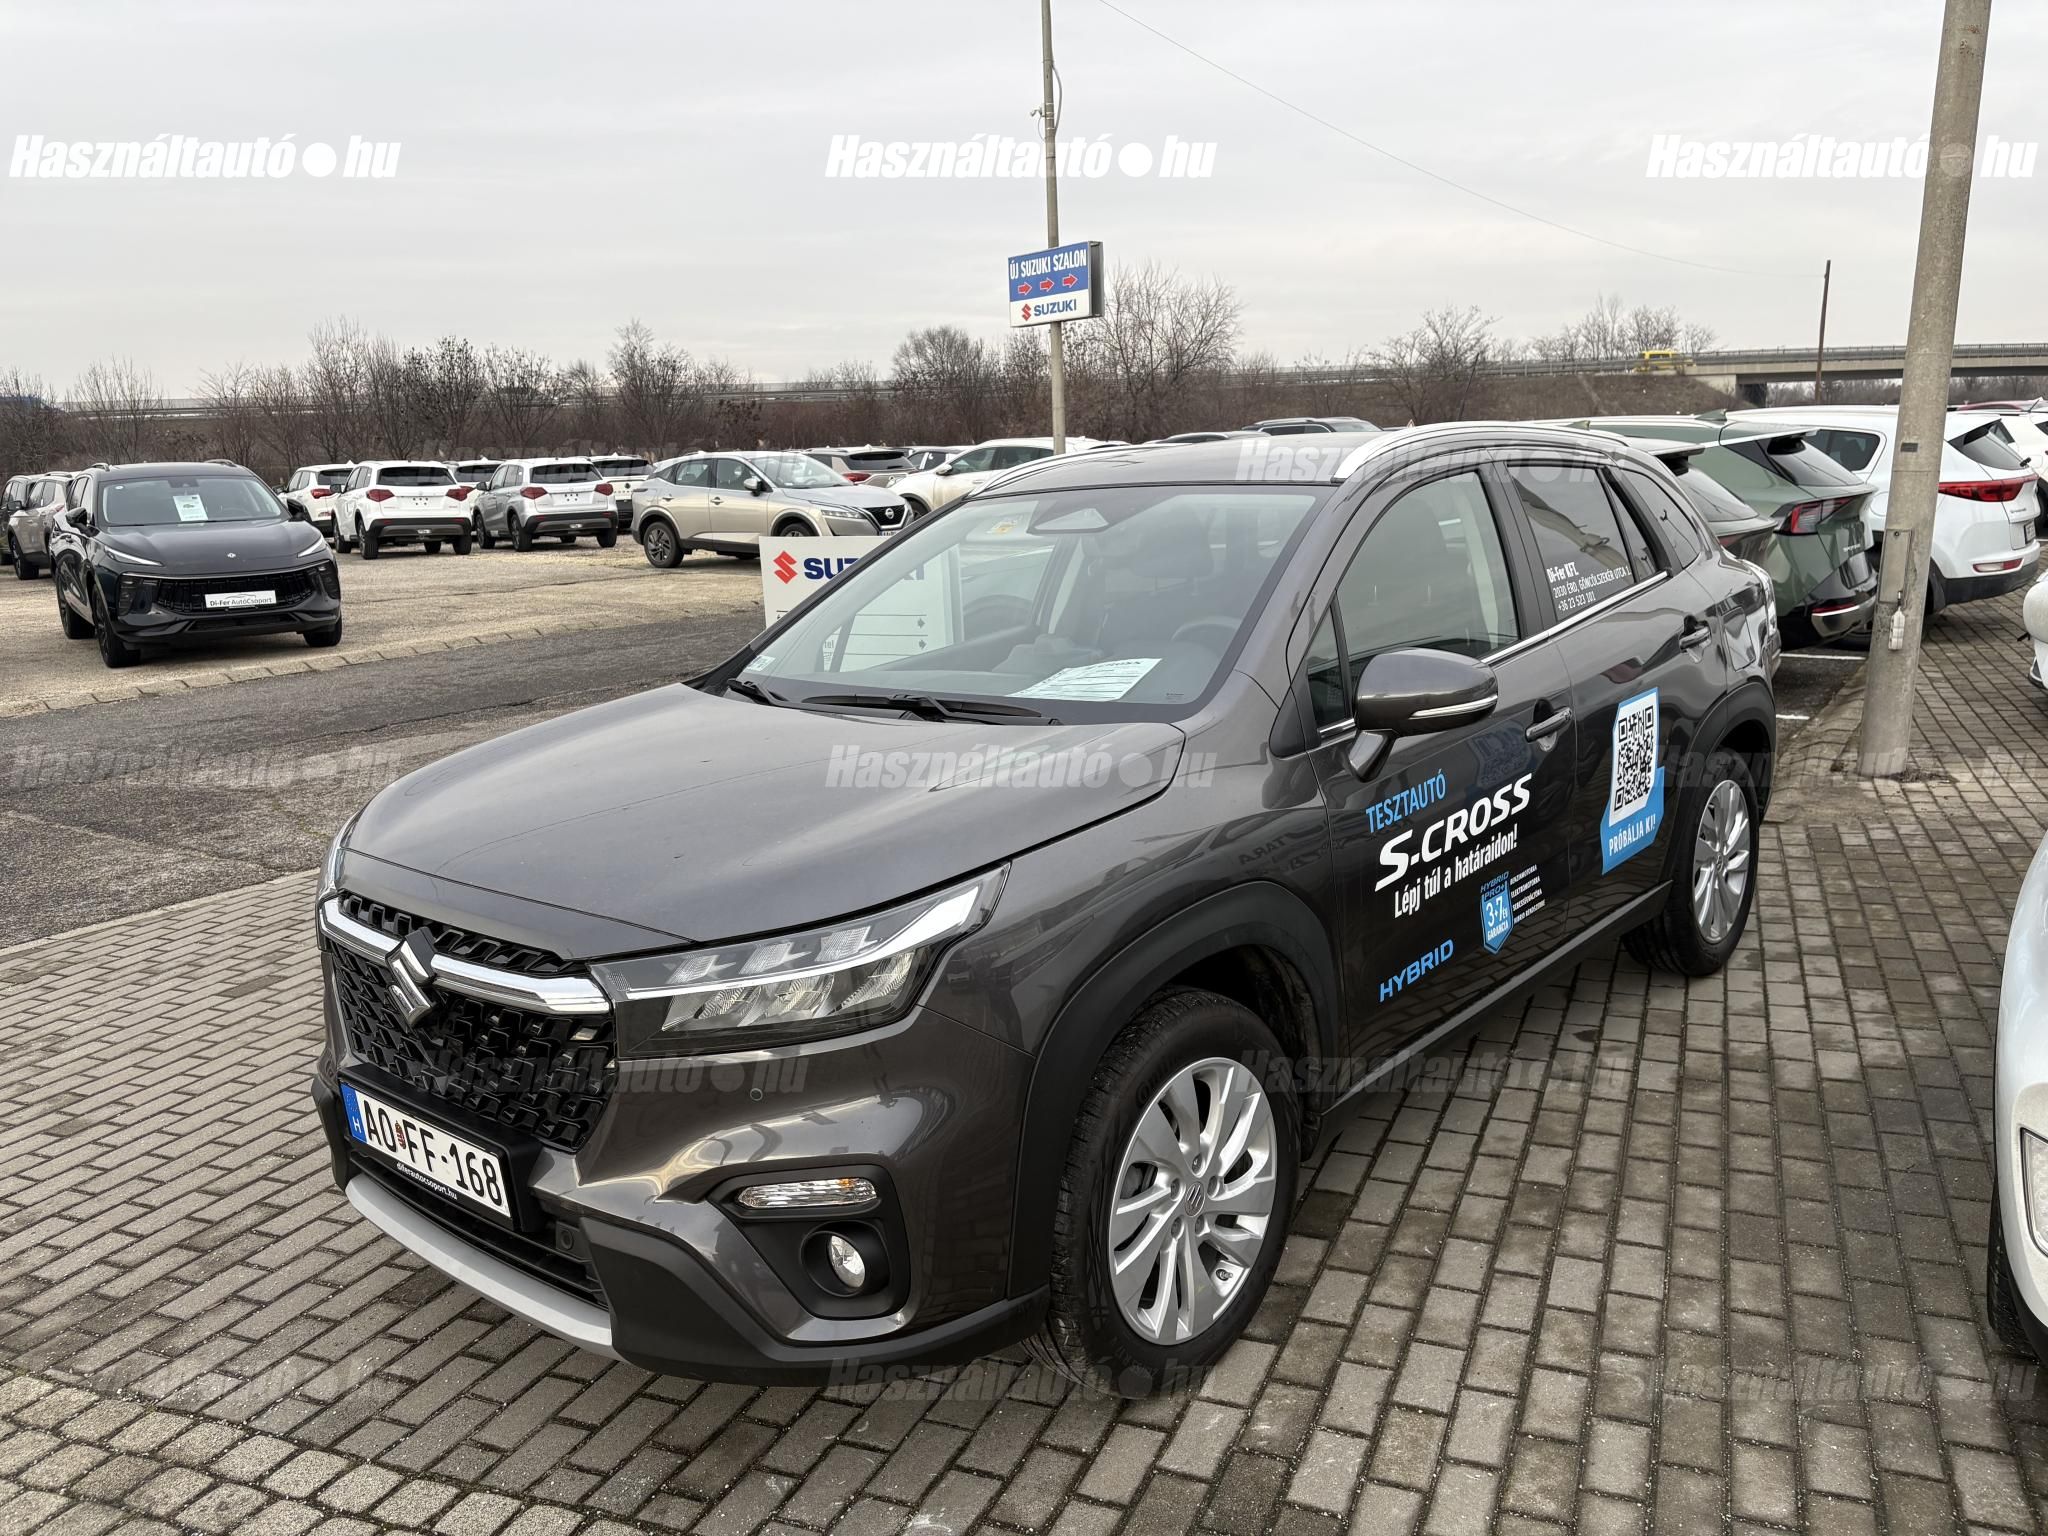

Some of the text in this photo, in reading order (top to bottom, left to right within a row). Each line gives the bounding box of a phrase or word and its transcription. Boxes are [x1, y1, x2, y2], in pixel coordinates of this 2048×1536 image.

[1010, 249, 1086, 279] ÚJ SUZUKI SZALON
[1034, 299, 1077, 317] SUZUKI
[1366, 768, 1447, 833] TESZTAUTÓ
[1374, 773, 1532, 892] S-CROSS
[1609, 813, 1656, 856] PRÓBÁLJA KI!
[1394, 823, 1518, 918] Lépj túl a határaidon!
[1480, 871, 1509, 893] HYBRID
[1487, 920, 1509, 941] GARANCIA
[1379, 939, 1454, 1002] HYBRID
[352, 1116, 361, 1134] H
